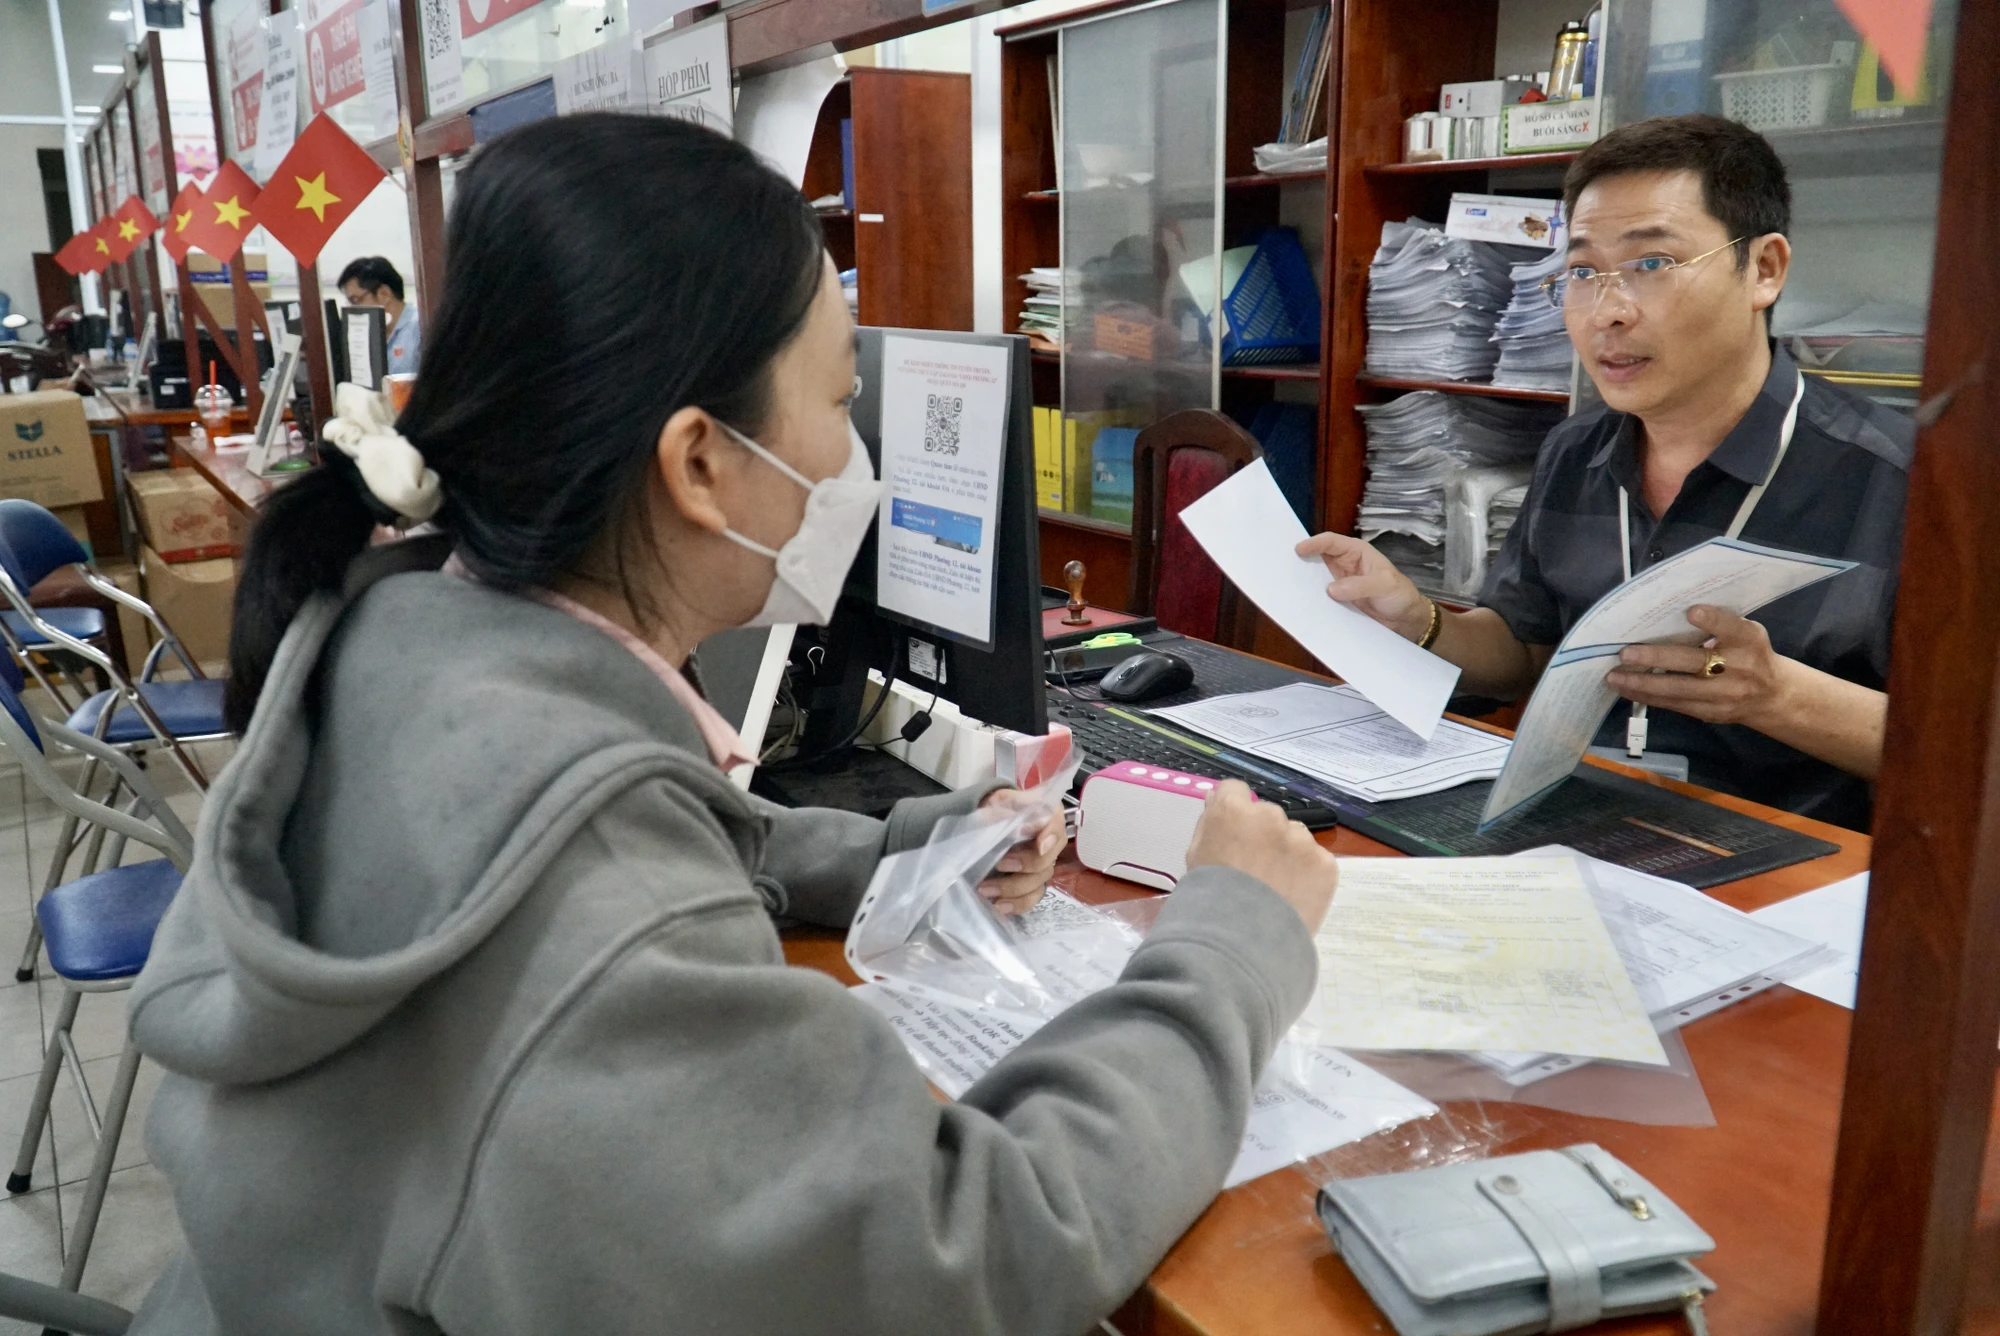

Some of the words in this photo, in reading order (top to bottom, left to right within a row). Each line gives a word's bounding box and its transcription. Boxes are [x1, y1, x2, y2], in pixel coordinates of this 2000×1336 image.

[681, 57, 710, 91] PHÍM
[1557, 123, 1582, 134] SÁNG
[7, 445, 63, 461] STELLA
